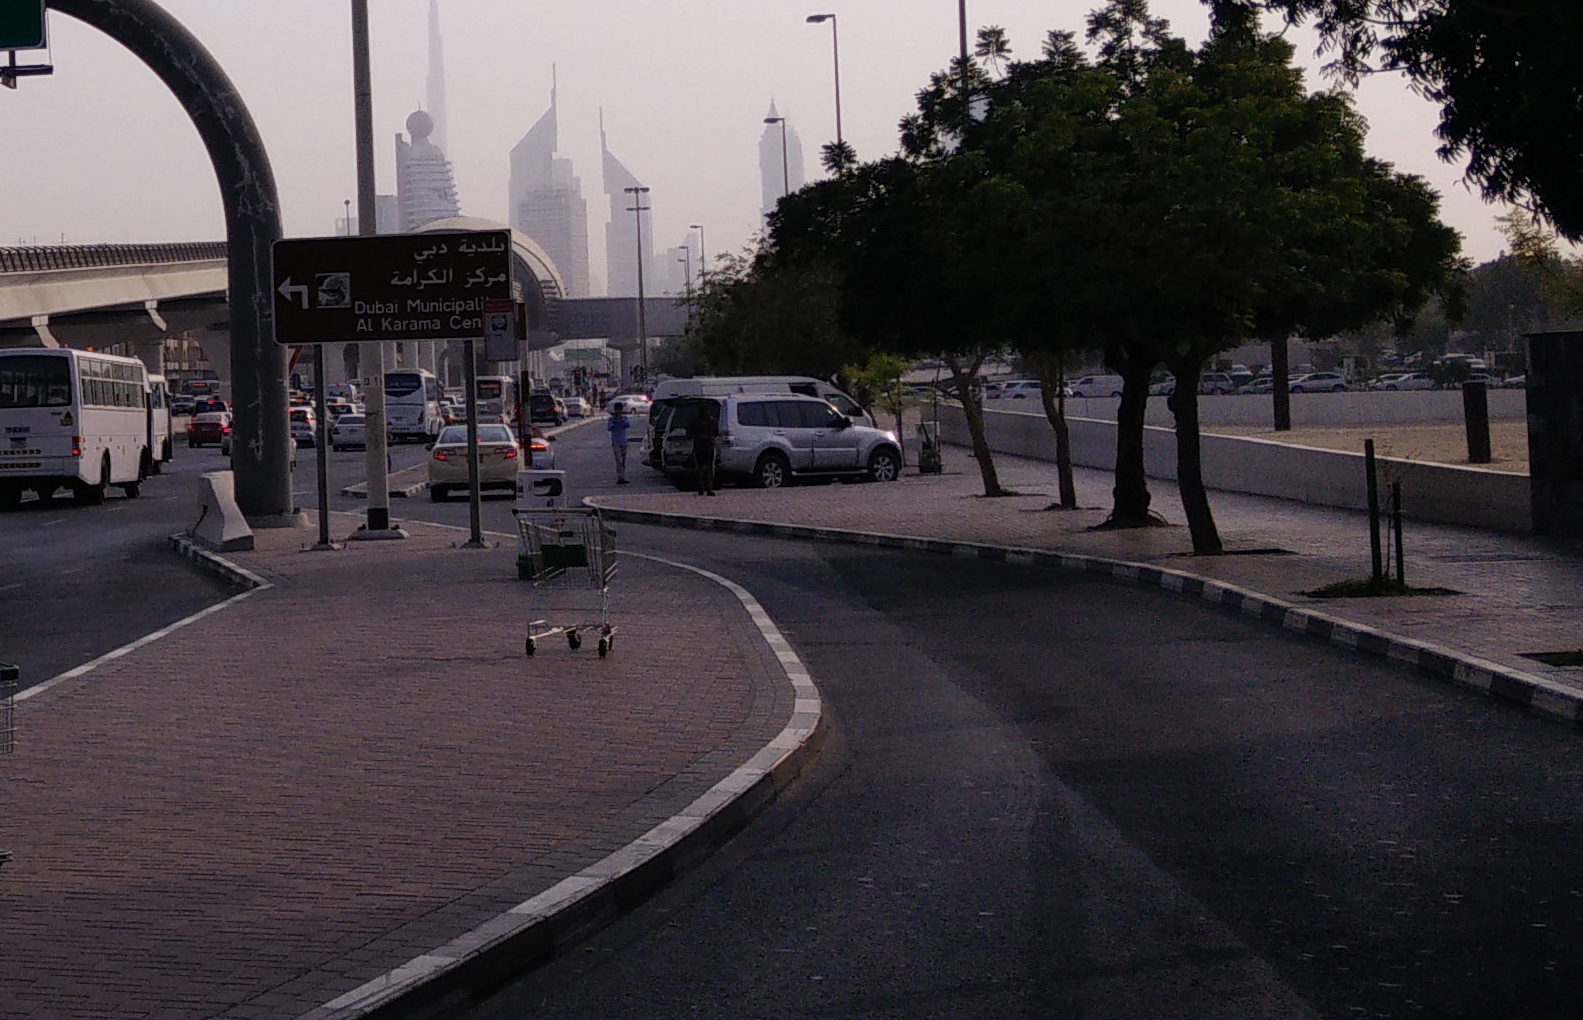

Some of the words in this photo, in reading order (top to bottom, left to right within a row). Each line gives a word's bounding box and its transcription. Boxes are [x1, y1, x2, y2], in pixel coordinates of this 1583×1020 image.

[414, 243, 449, 264] دبي
[457, 236, 506, 258] بلدية
[390, 267, 454, 291] الكرامة
[463, 266, 508, 288] مركز
[353, 298, 400, 315] Dubai
[406, 295, 490, 314] Municipali
[356, 318, 374, 333] Al
[381, 316, 442, 332] Karama
[449, 315, 483, 330] Cen
